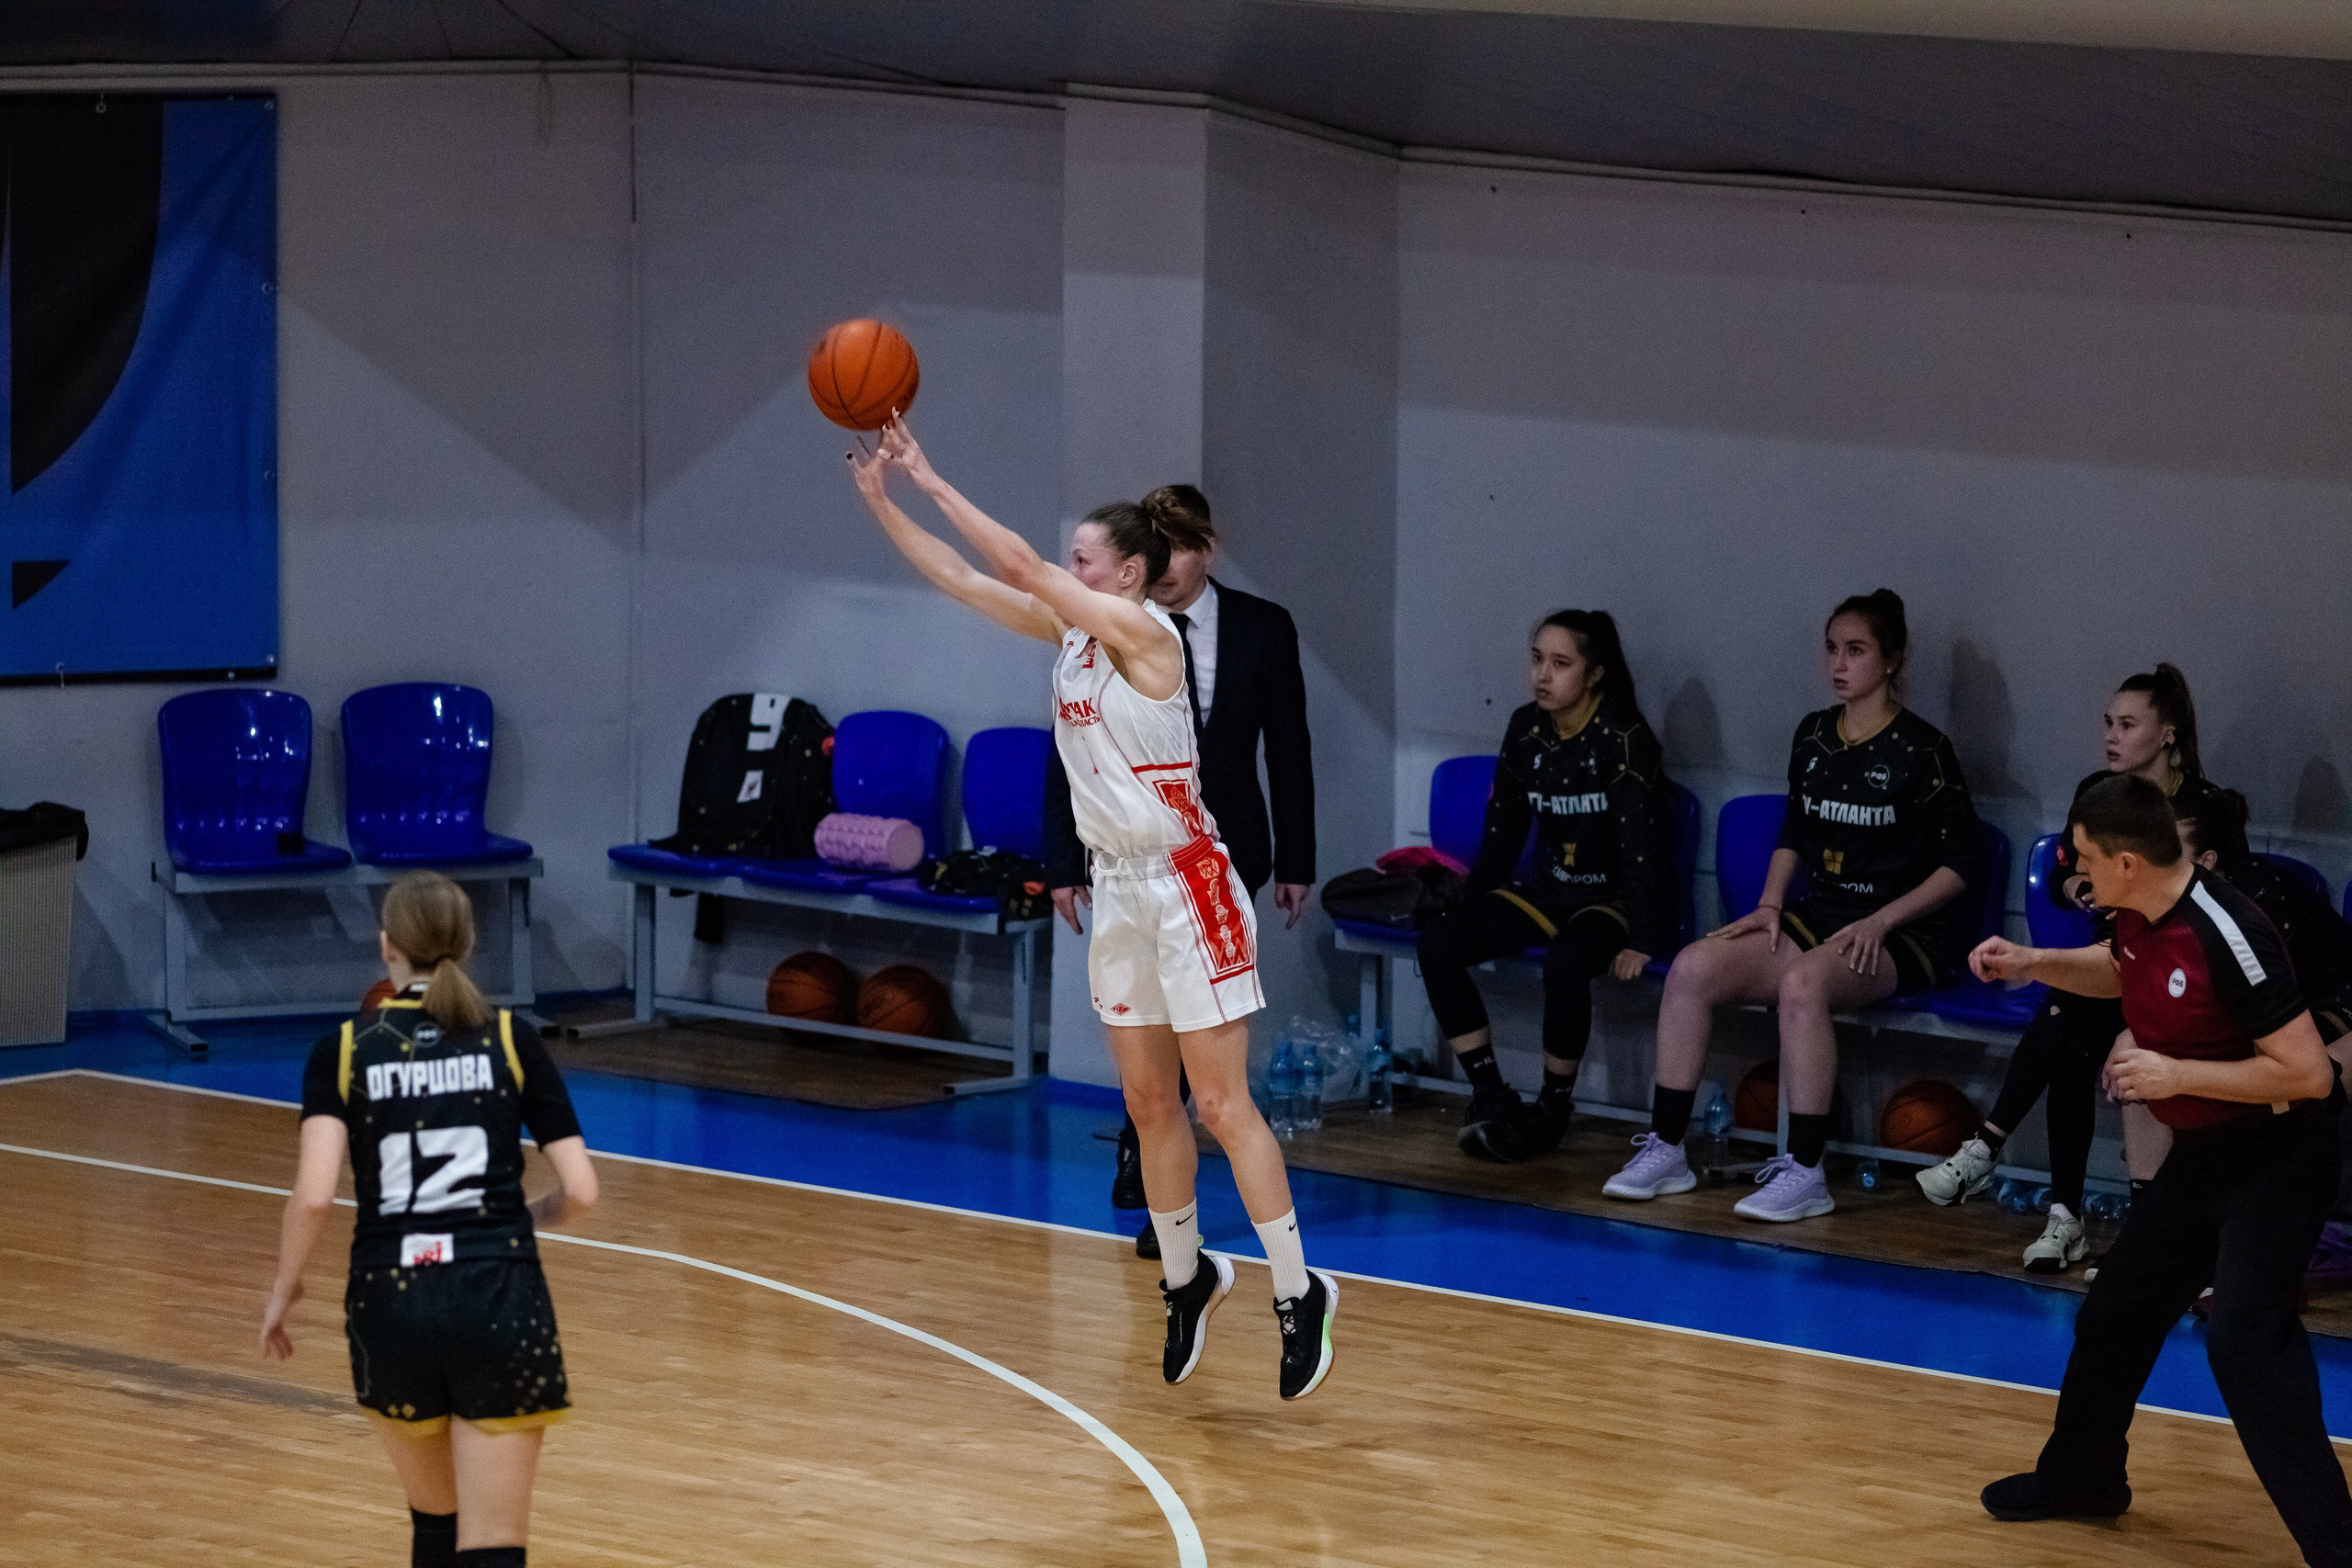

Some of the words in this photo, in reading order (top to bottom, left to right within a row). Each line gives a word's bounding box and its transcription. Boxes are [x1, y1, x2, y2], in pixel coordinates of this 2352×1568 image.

[746, 694, 791, 751] 9
[1802, 794, 1896, 826] У-АТЛАНТА
[367, 1054, 494, 1101] ОГУРЦОВА
[378, 1125, 489, 1216] 12
